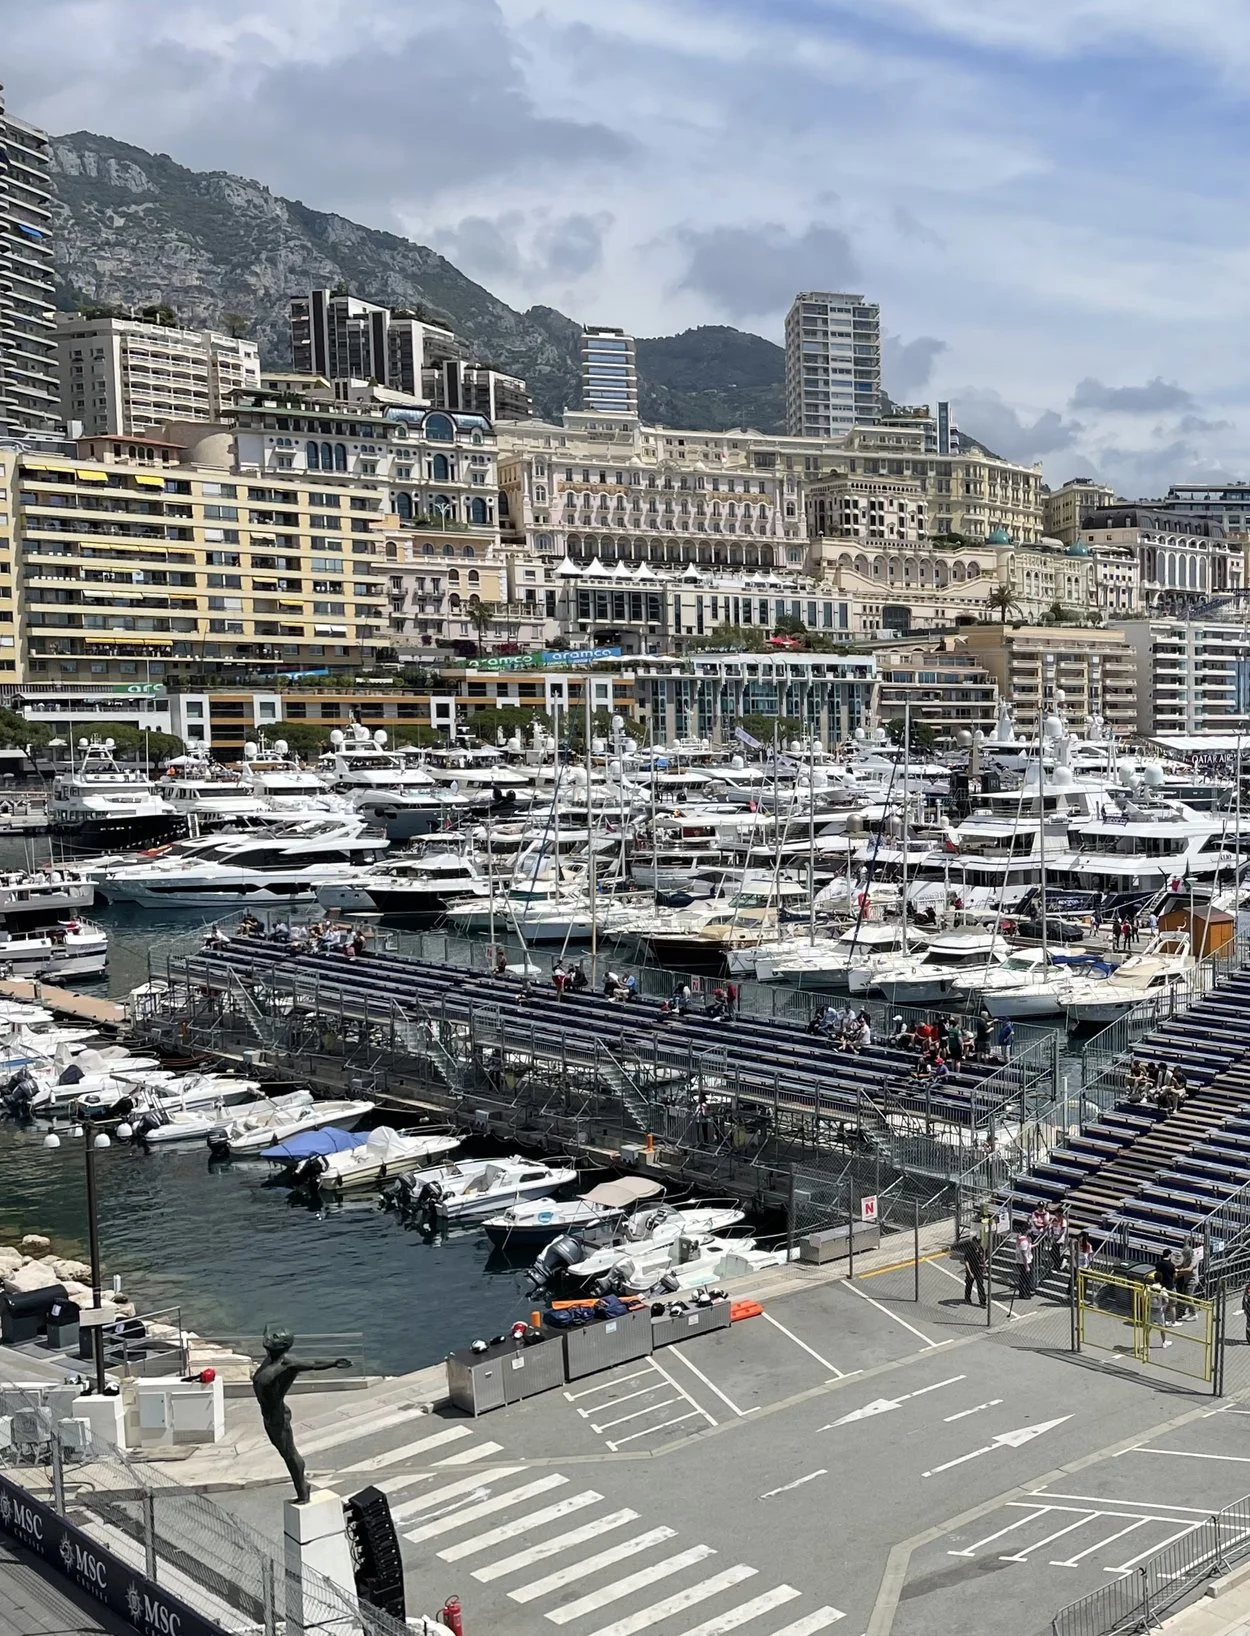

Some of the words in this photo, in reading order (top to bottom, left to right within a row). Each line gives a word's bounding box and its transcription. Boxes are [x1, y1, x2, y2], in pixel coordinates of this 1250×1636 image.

[552, 649, 612, 660] aramco
[1191, 754, 1218, 764] QATAR
[865, 1202, 874, 1215] N
[13, 1498, 43, 1540] MSC
[75, 1544, 107, 1588] MSC
[143, 1593, 181, 1636] MSC
